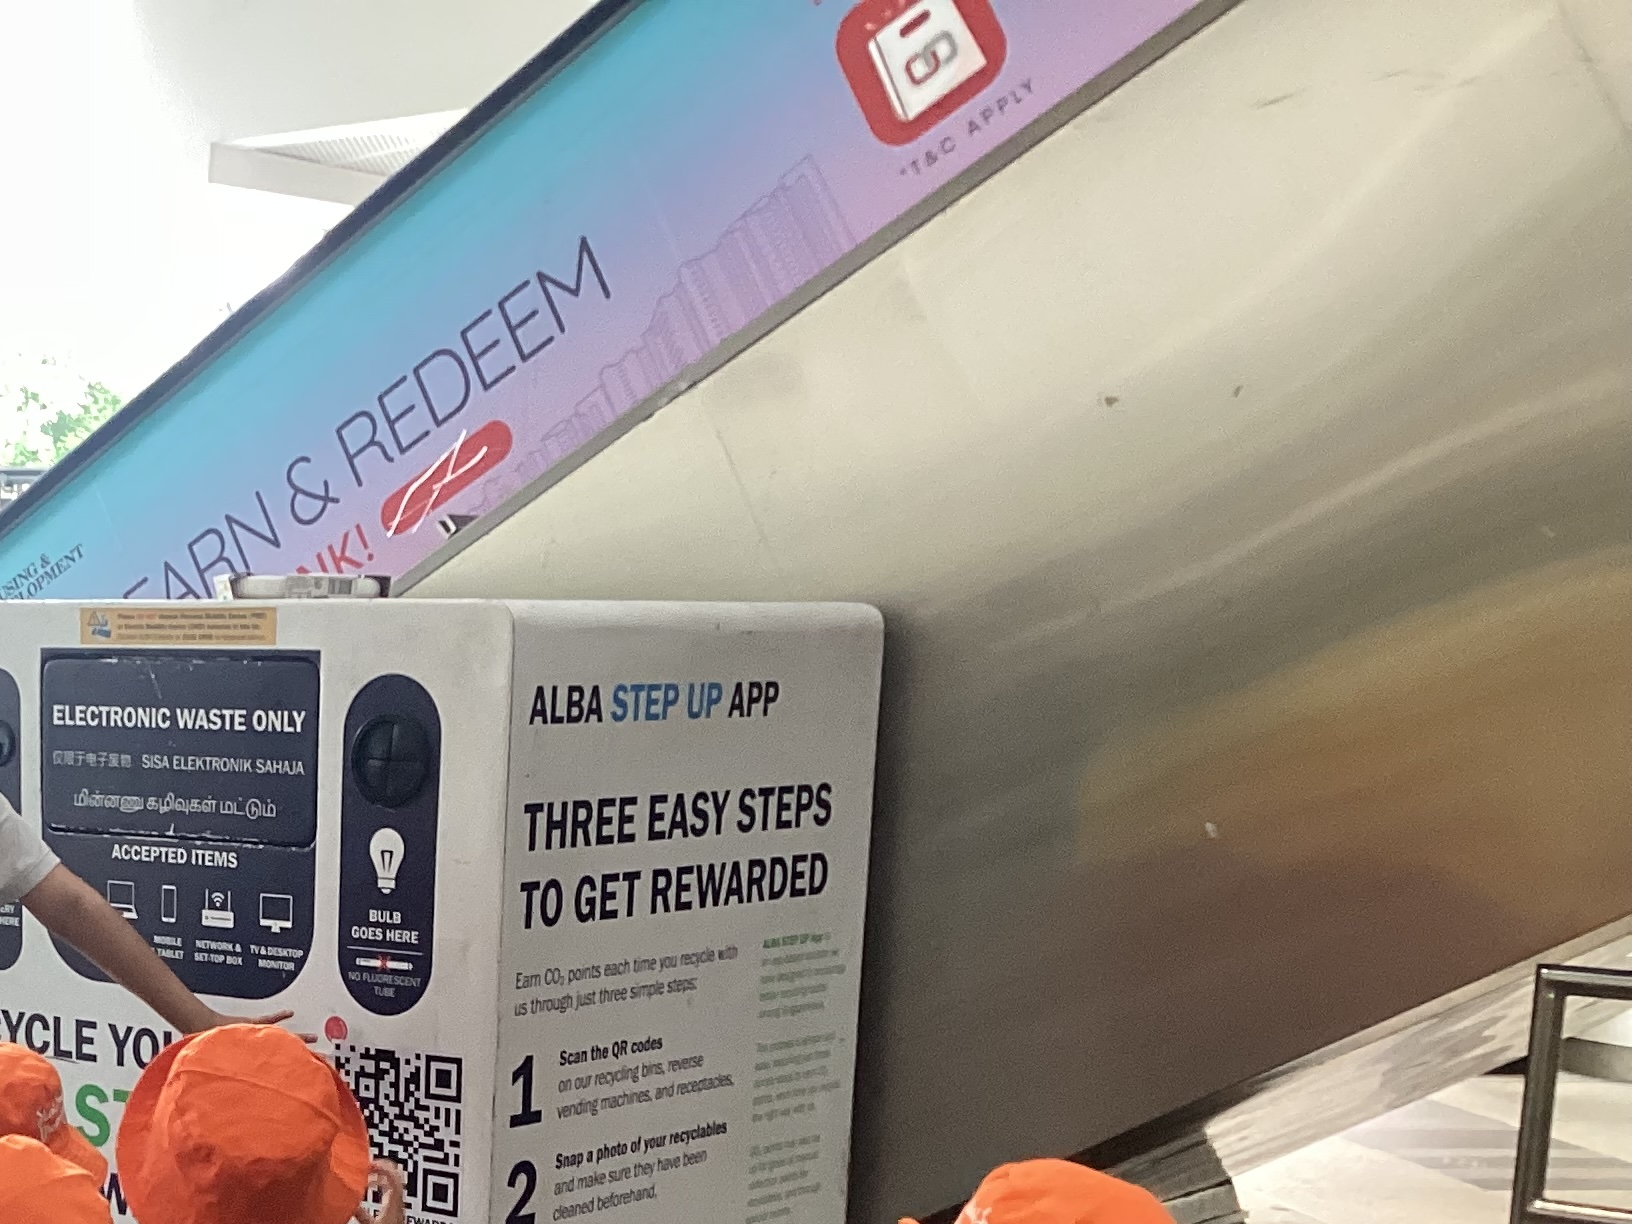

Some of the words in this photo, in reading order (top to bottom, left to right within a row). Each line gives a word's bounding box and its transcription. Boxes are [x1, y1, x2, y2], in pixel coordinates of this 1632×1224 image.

[967, 77, 1035, 138] APPLY
[286, 455, 341, 526] &
[335, 235, 612, 487] REDEEM
[52, 704, 170, 729] ELECTRONIC
[176, 708, 247, 731] WASTE
[252, 710, 306, 733] ONLY
[529, 684, 603, 726] ALBA
[610, 683, 679, 722] STEP
[687, 681, 723, 719] UP
[728, 680, 780, 718] APP
[142, 754, 169, 769] SISA
[173, 755, 252, 773] ELEKTRONIK
[256, 758, 305, 775] SAHAJA
[524, 795, 638, 852] THREE
[647, 789, 731, 841] EASY
[736, 782, 832, 833] STEPS
[111, 843, 186, 865] ACCEPTED
[191, 847, 238, 869] ITEMS
[520, 878, 563, 930] TO
[574, 870, 641, 922] GET
[650, 852, 829, 915] REWARDED
[351, 926, 383, 940] GOES
[386, 929, 419, 944] HERE
[369, 909, 401, 924] BULB
[195, 940, 234, 952] NETWORK
[515, 971, 542, 990] Earn
[567, 961, 601, 985] points
[603, 960, 631, 977] each
[632, 955, 657, 974] time
[658, 956, 678, 973] you
[679, 948, 716, 971] recycle
[514, 1000, 528, 1017] us
[530, 992, 573, 1015] through
[574, 989, 597, 1011] just
[599, 985, 628, 1003] three
[629, 980, 665, 1001] simple
[559, 1049, 588, 1068] Scan
[590, 1044, 609, 1063] the
[611, 1039, 628, 1059] QR
[630, 1034, 664, 1053] codes
[508, 1054, 543, 1129] 1
[558, 1077, 573, 1094] on
[574, 1074, 593, 1092] our
[594, 1062, 640, 1091] recycling
[666, 1054, 705, 1074] reverse
[556, 1096, 600, 1121] vending
[655, 1084, 676, 1101] and
[555, 1152, 584, 1173] Snap
[586, 1149, 594, 1164] a
[595, 1141, 629, 1163] photo
[630, 1137, 642, 1154] of
[643, 1135, 667, 1155] your
[668, 1120, 728, 1146] recyclables
[554, 1177, 575, 1197] and
[576, 1171, 607, 1189] make
[633, 1161, 657, 1180] they
[657, 1155, 682, 1173] have
[682, 1149, 708, 1167] been
[552, 1200, 595, 1222] cleaned
